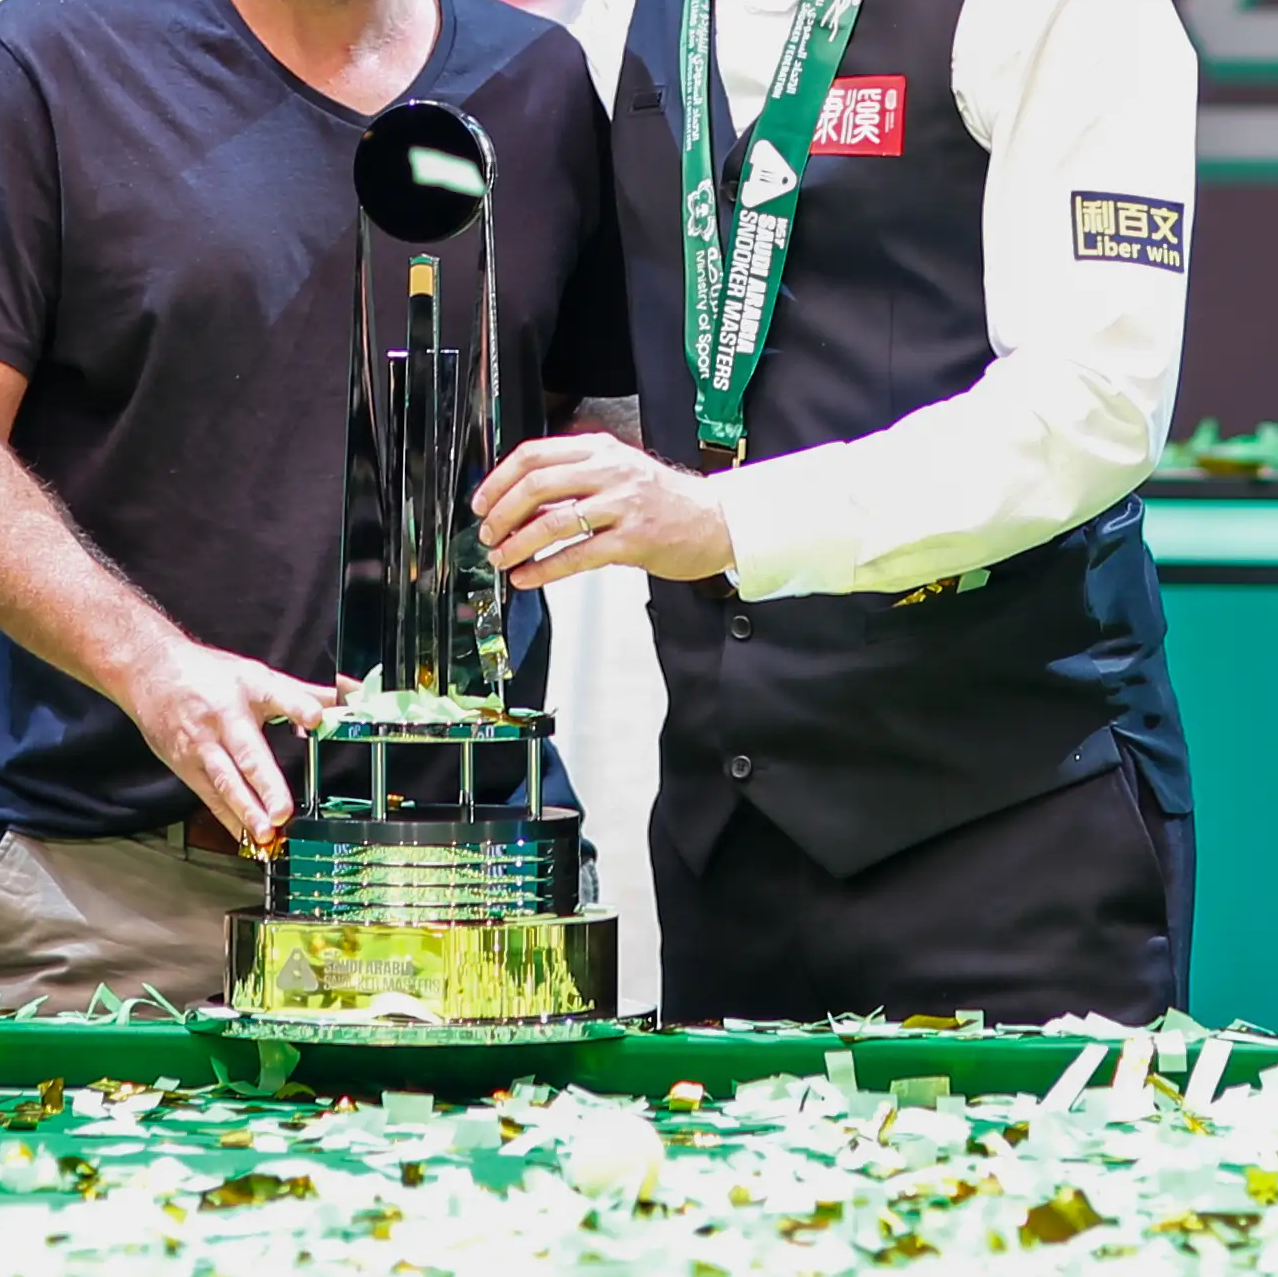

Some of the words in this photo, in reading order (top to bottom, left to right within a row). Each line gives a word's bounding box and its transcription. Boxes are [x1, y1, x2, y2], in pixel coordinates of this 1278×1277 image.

[726, 209, 758, 299] SNOOKER
[749, 213, 776, 278] SAUDI
[1075, 195, 1141, 259] Liber
[1146, 243, 1181, 267] win
[695, 249, 706, 311] Ministry
[698, 315, 711, 331] of
[713, 299, 743, 392] MASTERS
[735, 276, 767, 354] ARABIA
[695, 333, 712, 380] Sport
